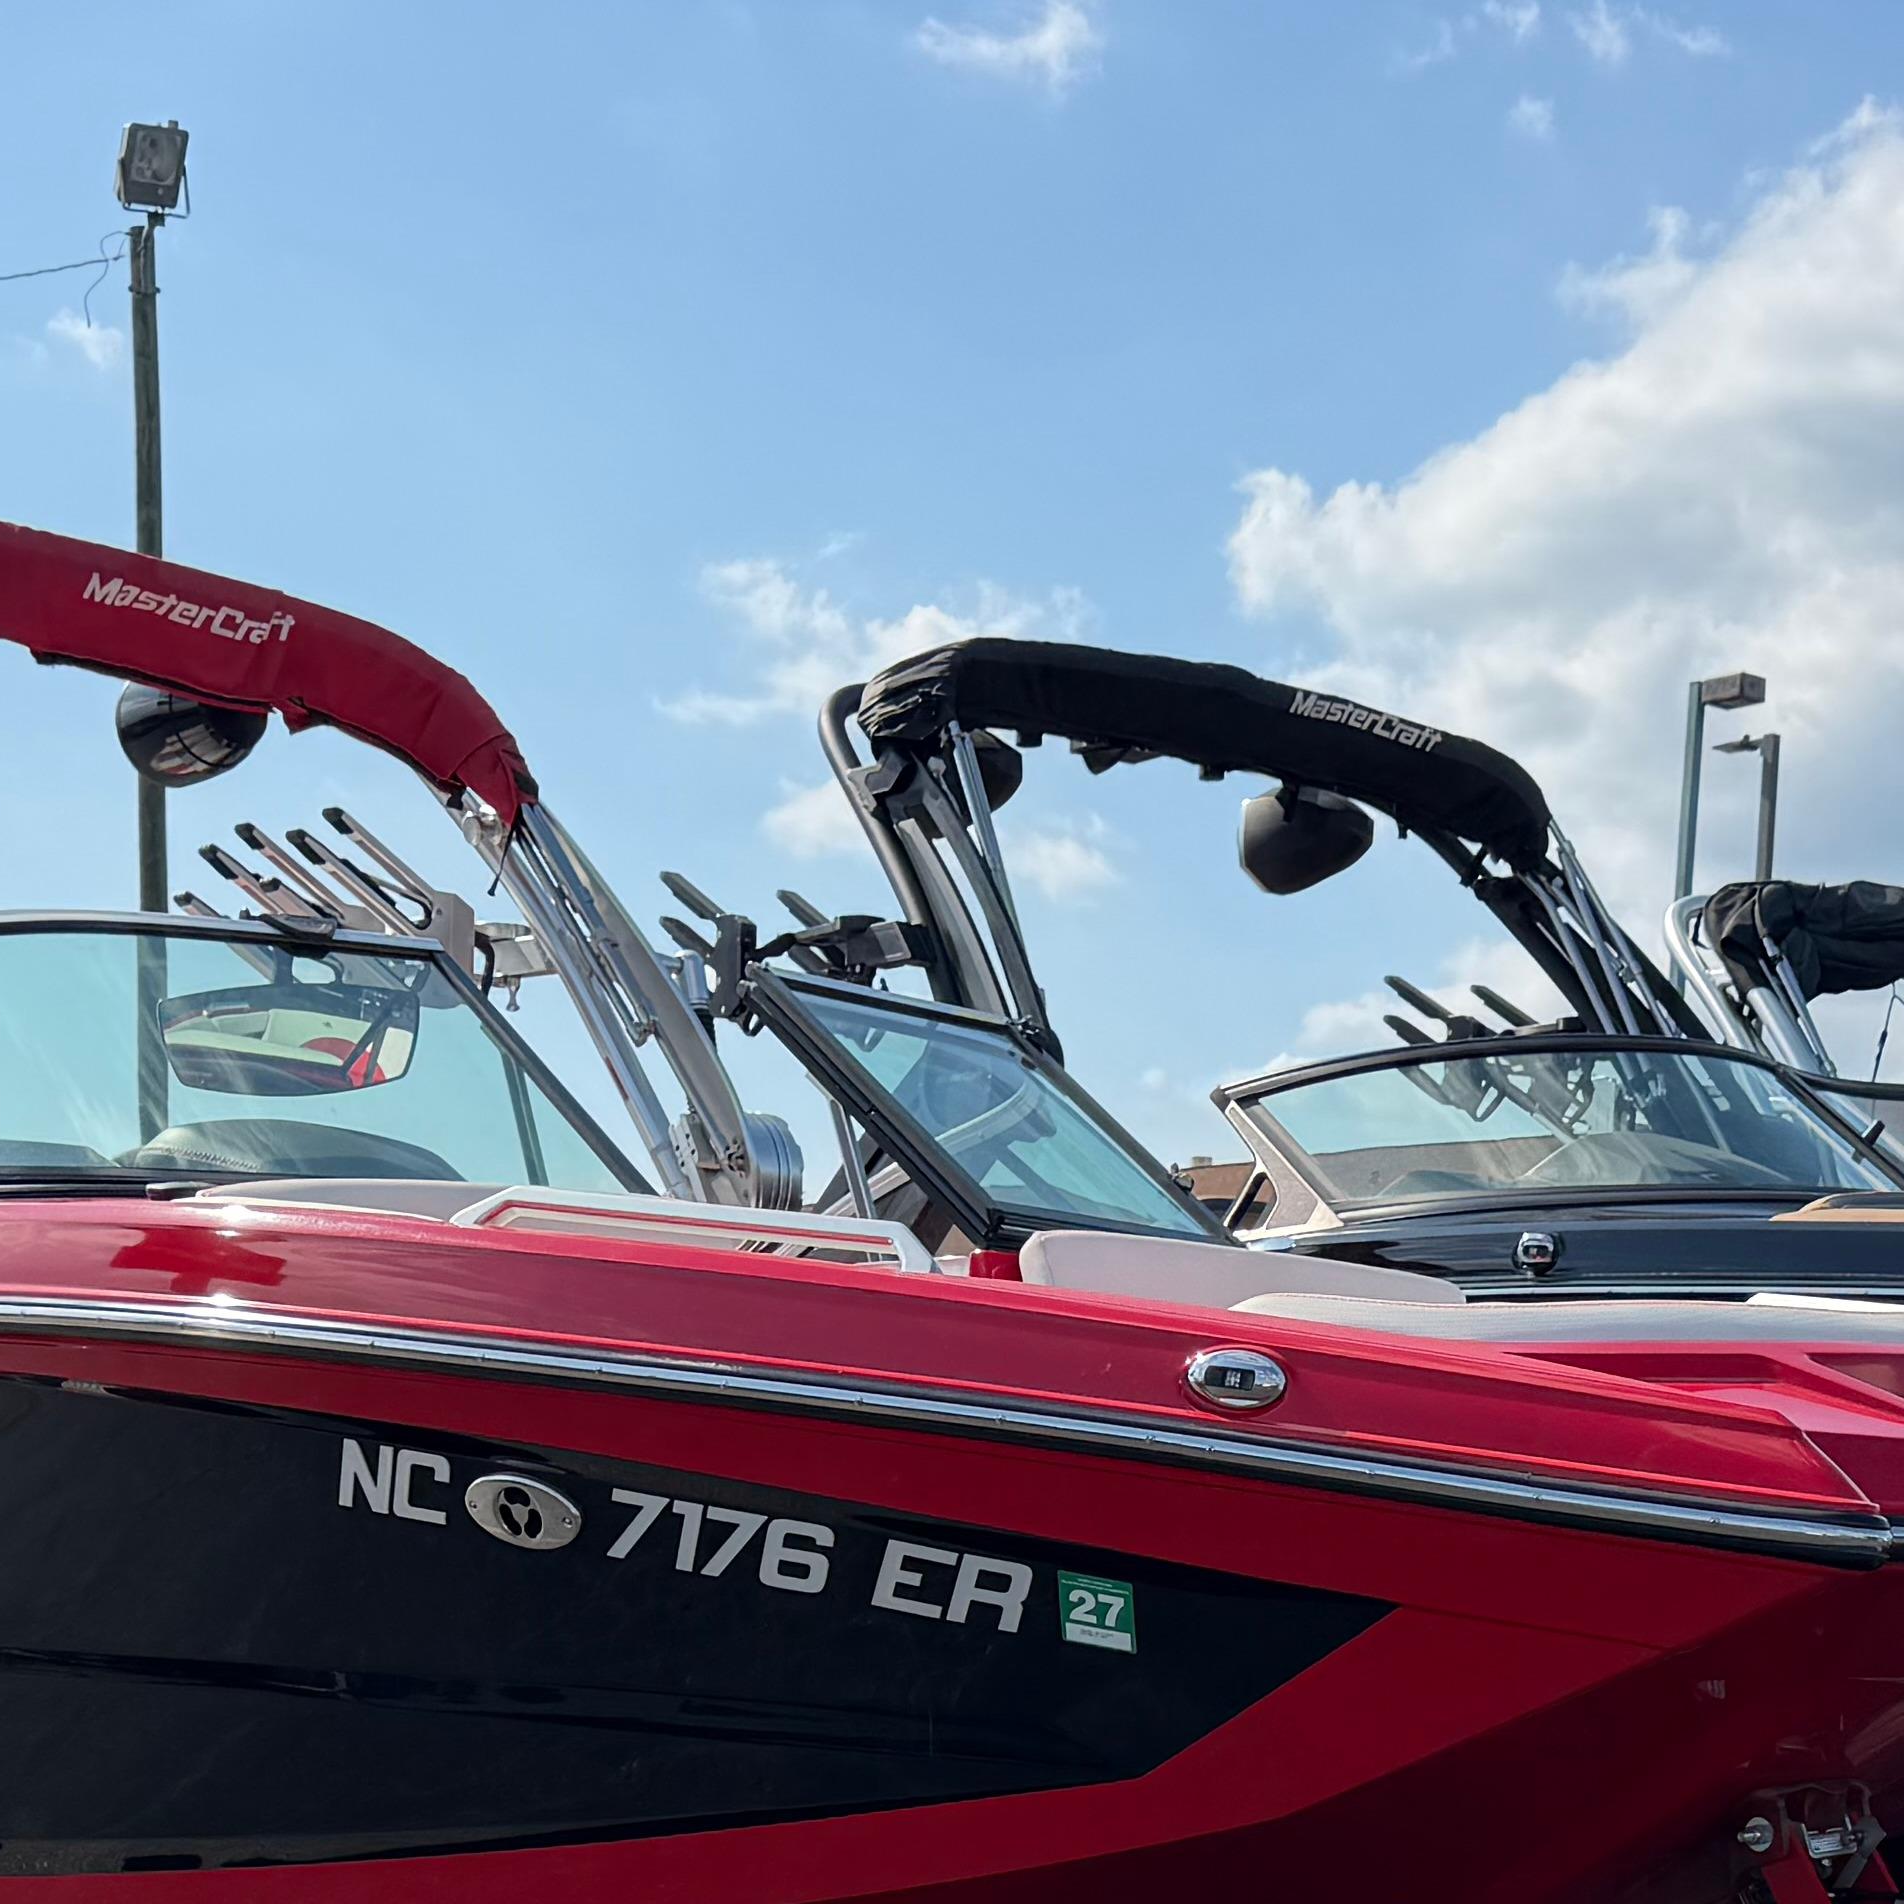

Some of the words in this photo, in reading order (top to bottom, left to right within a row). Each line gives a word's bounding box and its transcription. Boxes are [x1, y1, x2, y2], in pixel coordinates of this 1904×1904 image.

[1289, 690, 1443, 753] MasterCraft
[338, 1437, 451, 1526] NC
[605, 1487, 836, 1594] 7176
[870, 1537, 1034, 1634] ER
[1068, 1588, 1125, 1628] 27
